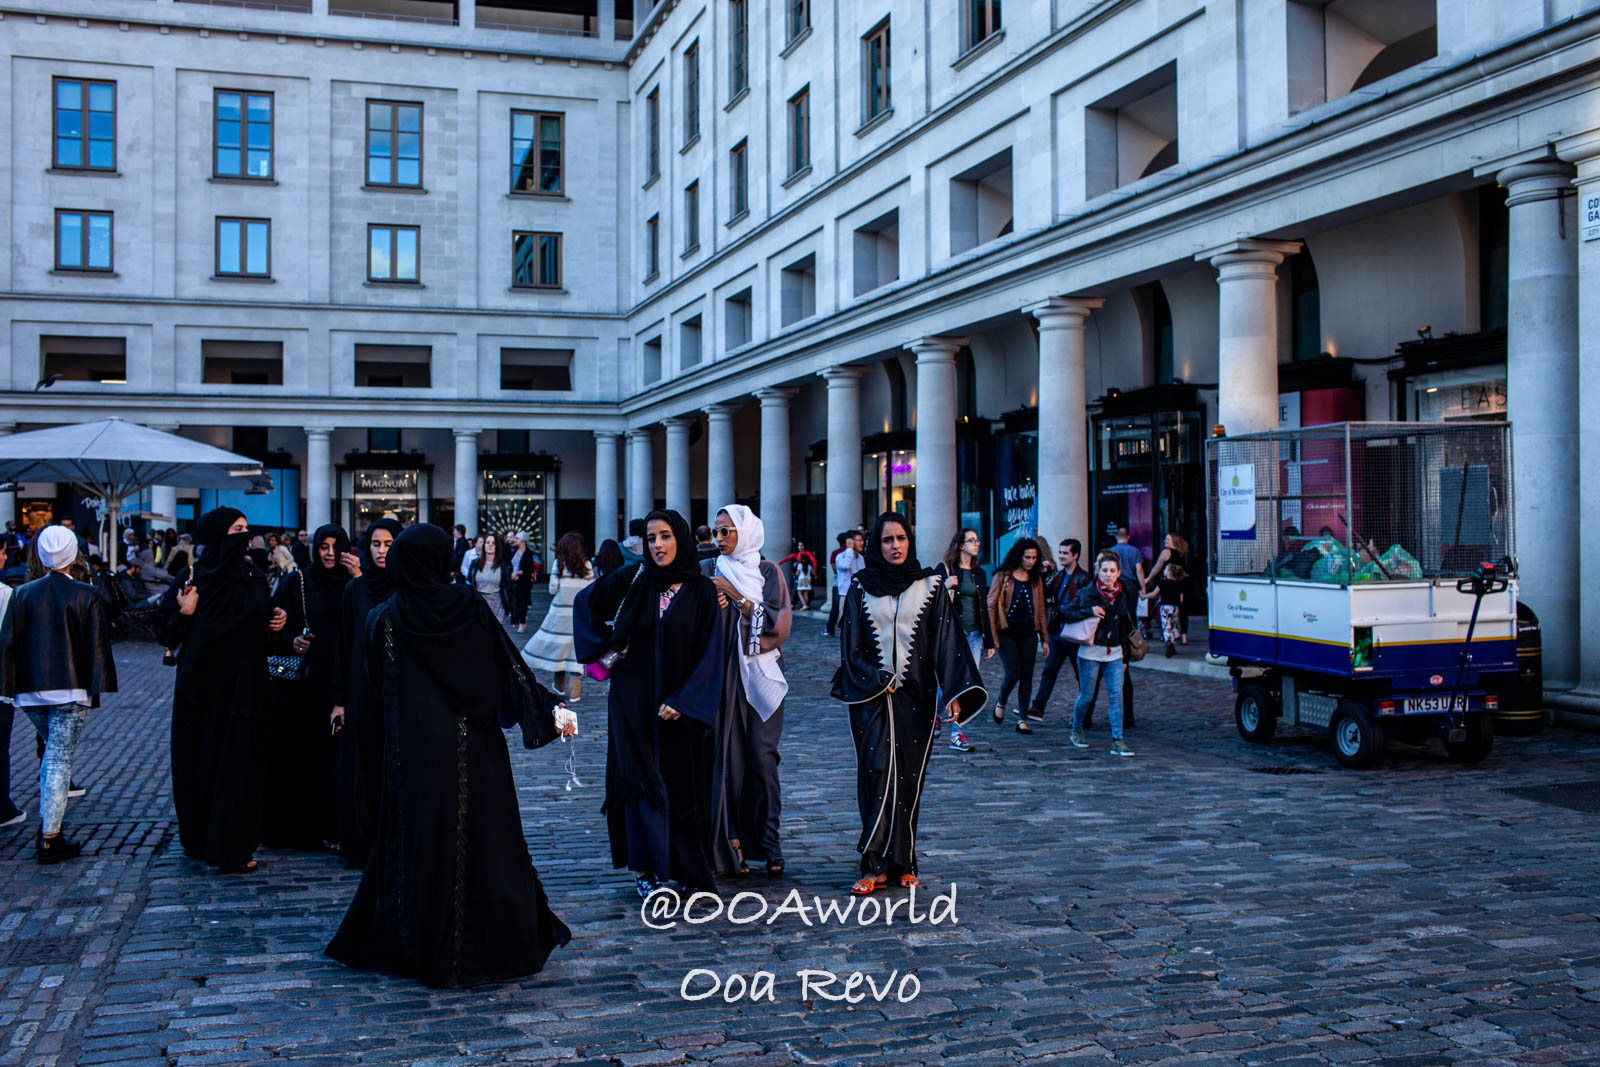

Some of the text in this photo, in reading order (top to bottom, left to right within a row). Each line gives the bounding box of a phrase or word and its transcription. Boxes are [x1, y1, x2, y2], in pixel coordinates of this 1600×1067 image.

[361, 479, 408, 488] MAGNUM
[491, 479, 536, 489] MAGNUM
[1441, 696, 1464, 709] UR
